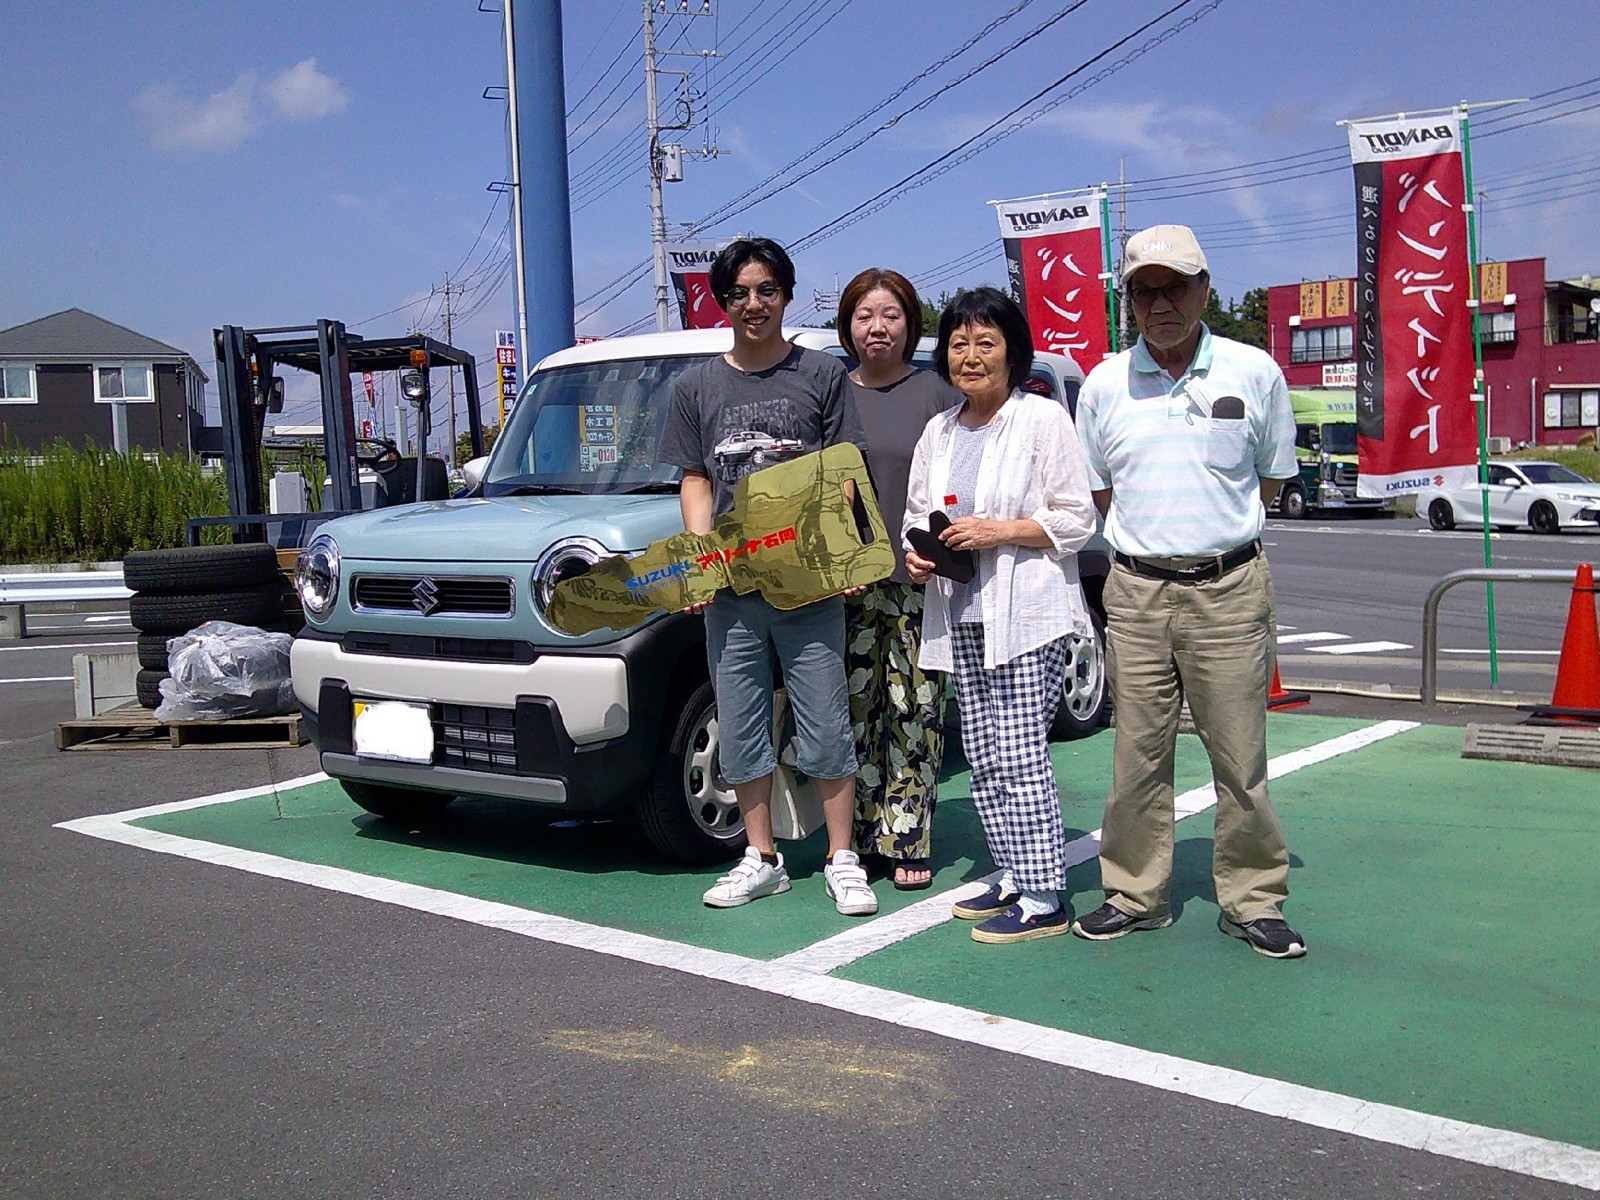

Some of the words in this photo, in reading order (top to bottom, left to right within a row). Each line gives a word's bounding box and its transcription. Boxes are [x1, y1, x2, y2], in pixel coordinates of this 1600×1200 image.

[585, 417, 614, 427] 木工事
[625, 559, 691, 589] SUZUKI
[695, 526, 796, 571] アリーナ石岡
